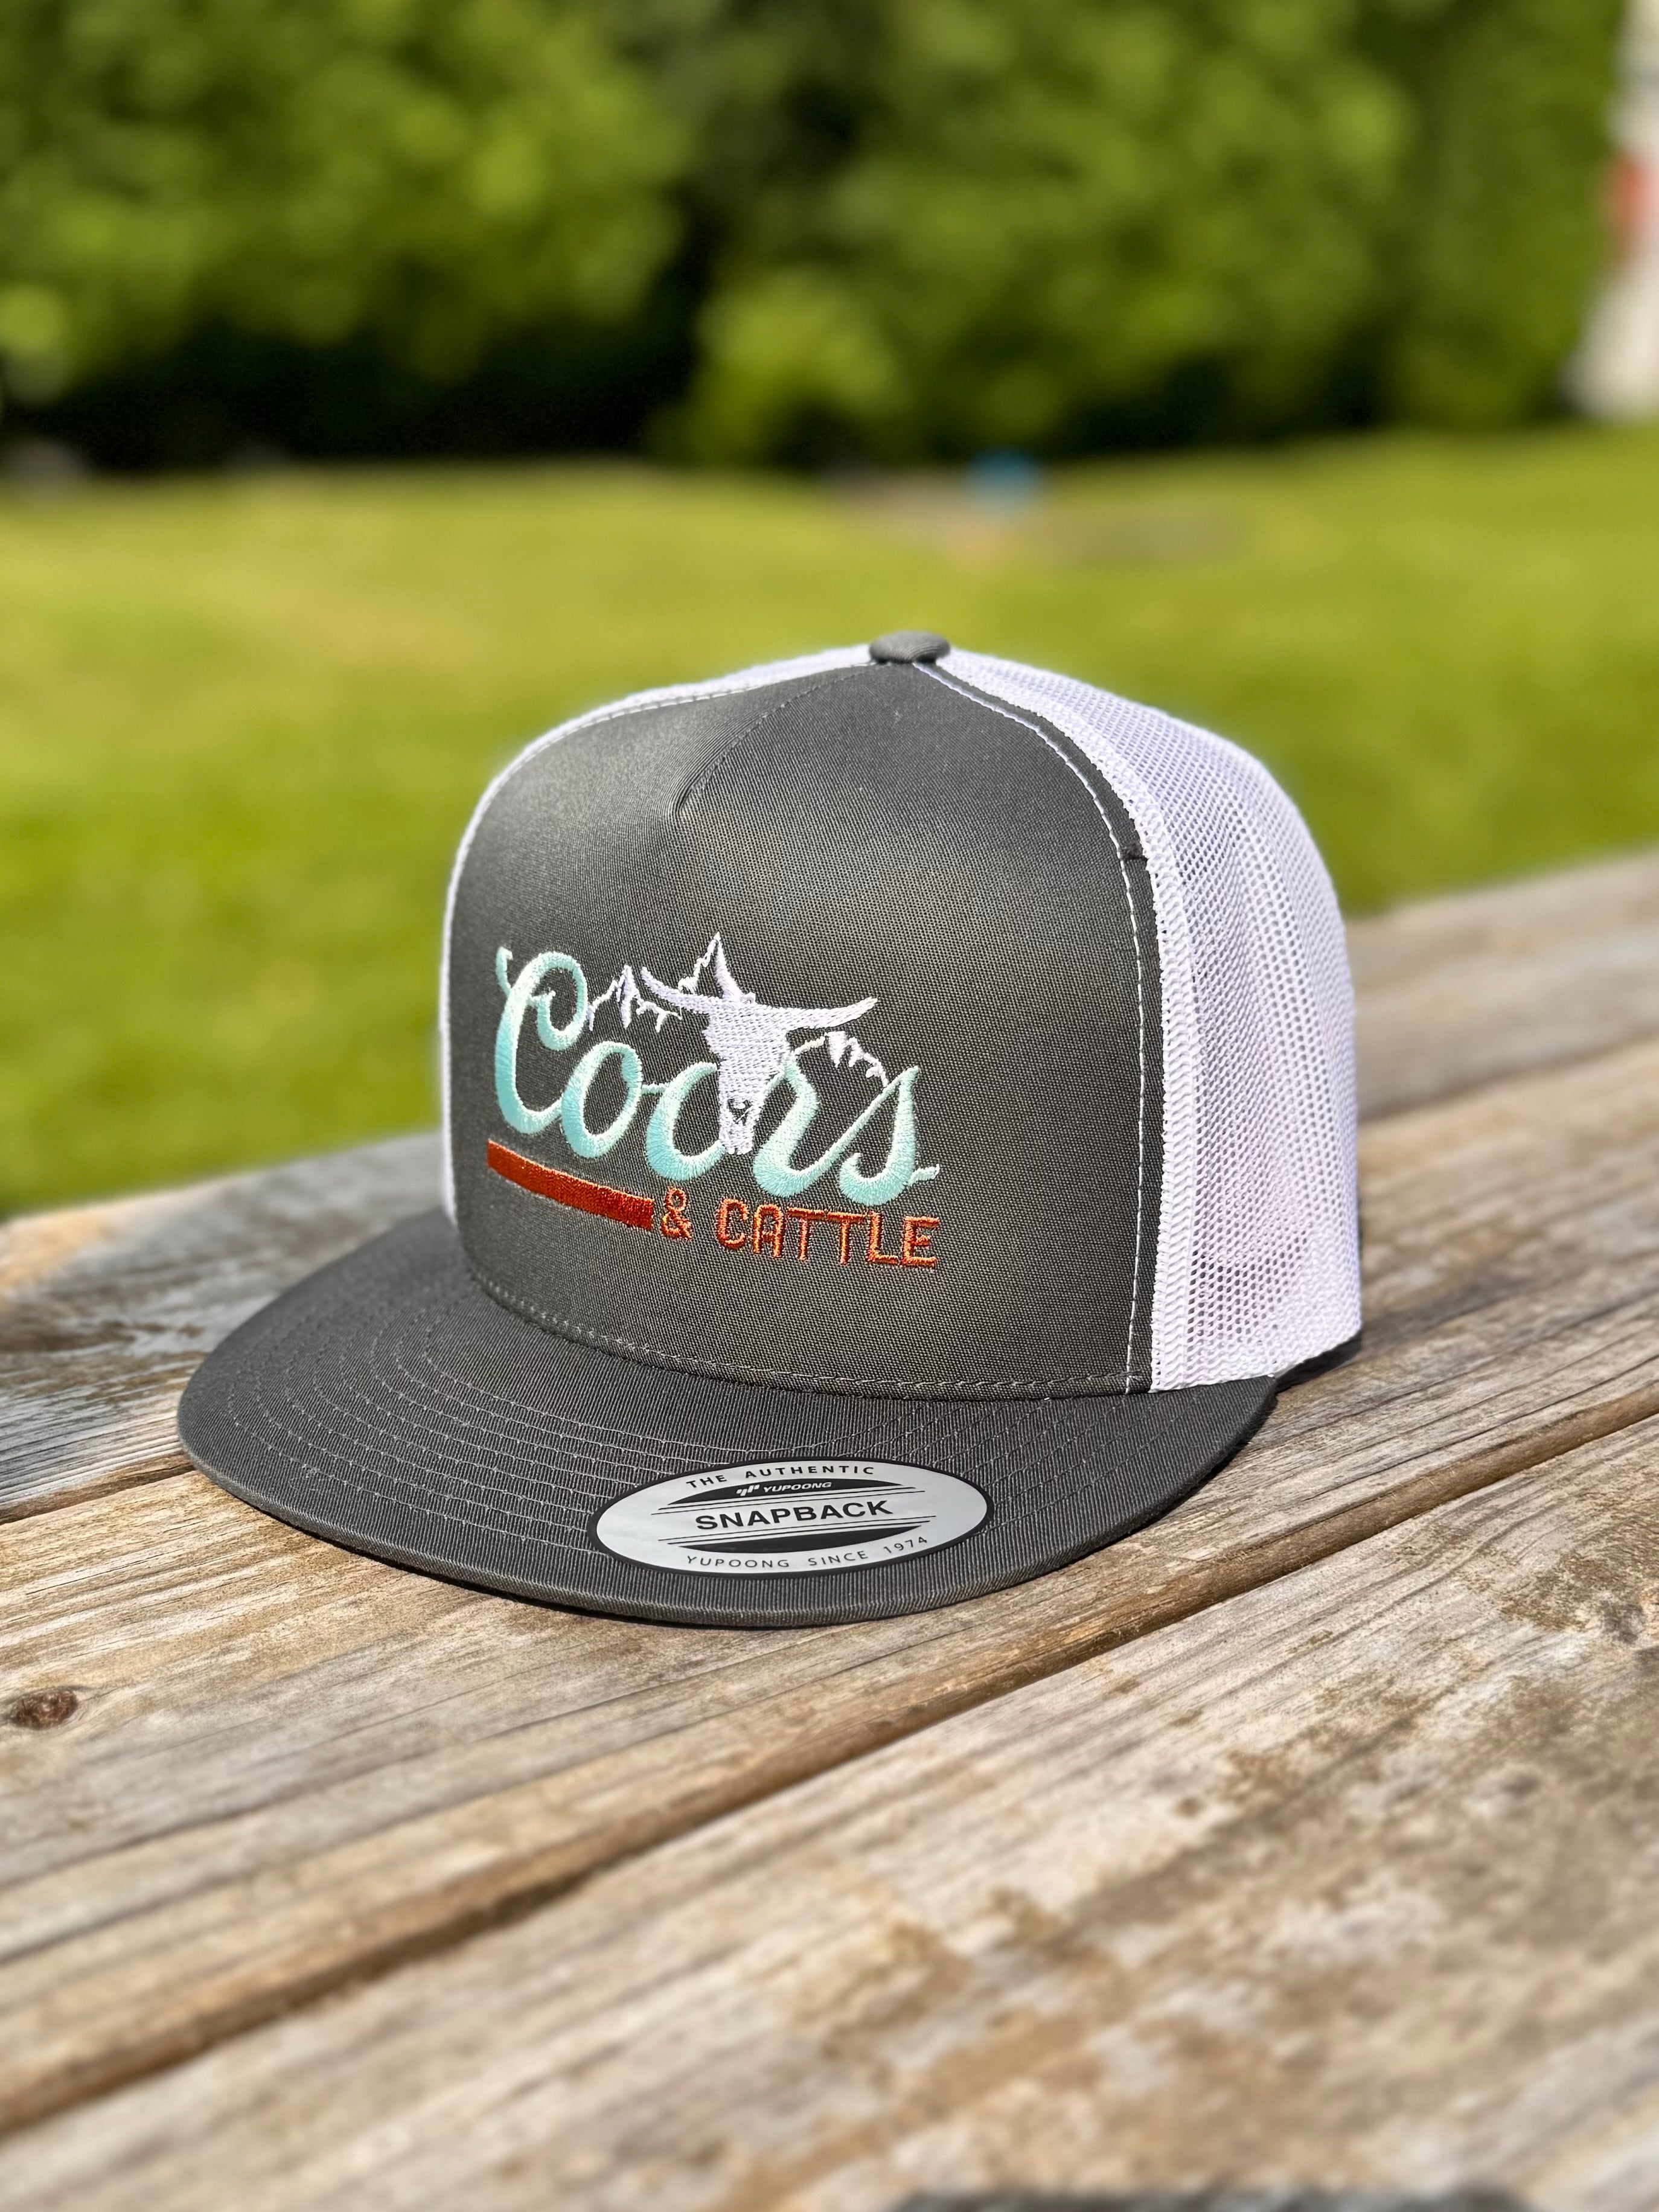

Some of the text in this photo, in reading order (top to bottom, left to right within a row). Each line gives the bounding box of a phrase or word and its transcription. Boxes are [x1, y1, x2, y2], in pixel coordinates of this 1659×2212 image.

[495, 946, 940, 1206] Coors
[660, 1187, 941, 1269] & CATTLE
[686, 1465, 875, 1489] THE AUTHENTIC
[763, 1482, 832, 1492] YUPOONG
[695, 1500, 893, 1530] SNAPBACK
[687, 1536, 928, 1568] YUPOONG SINCE 1974
